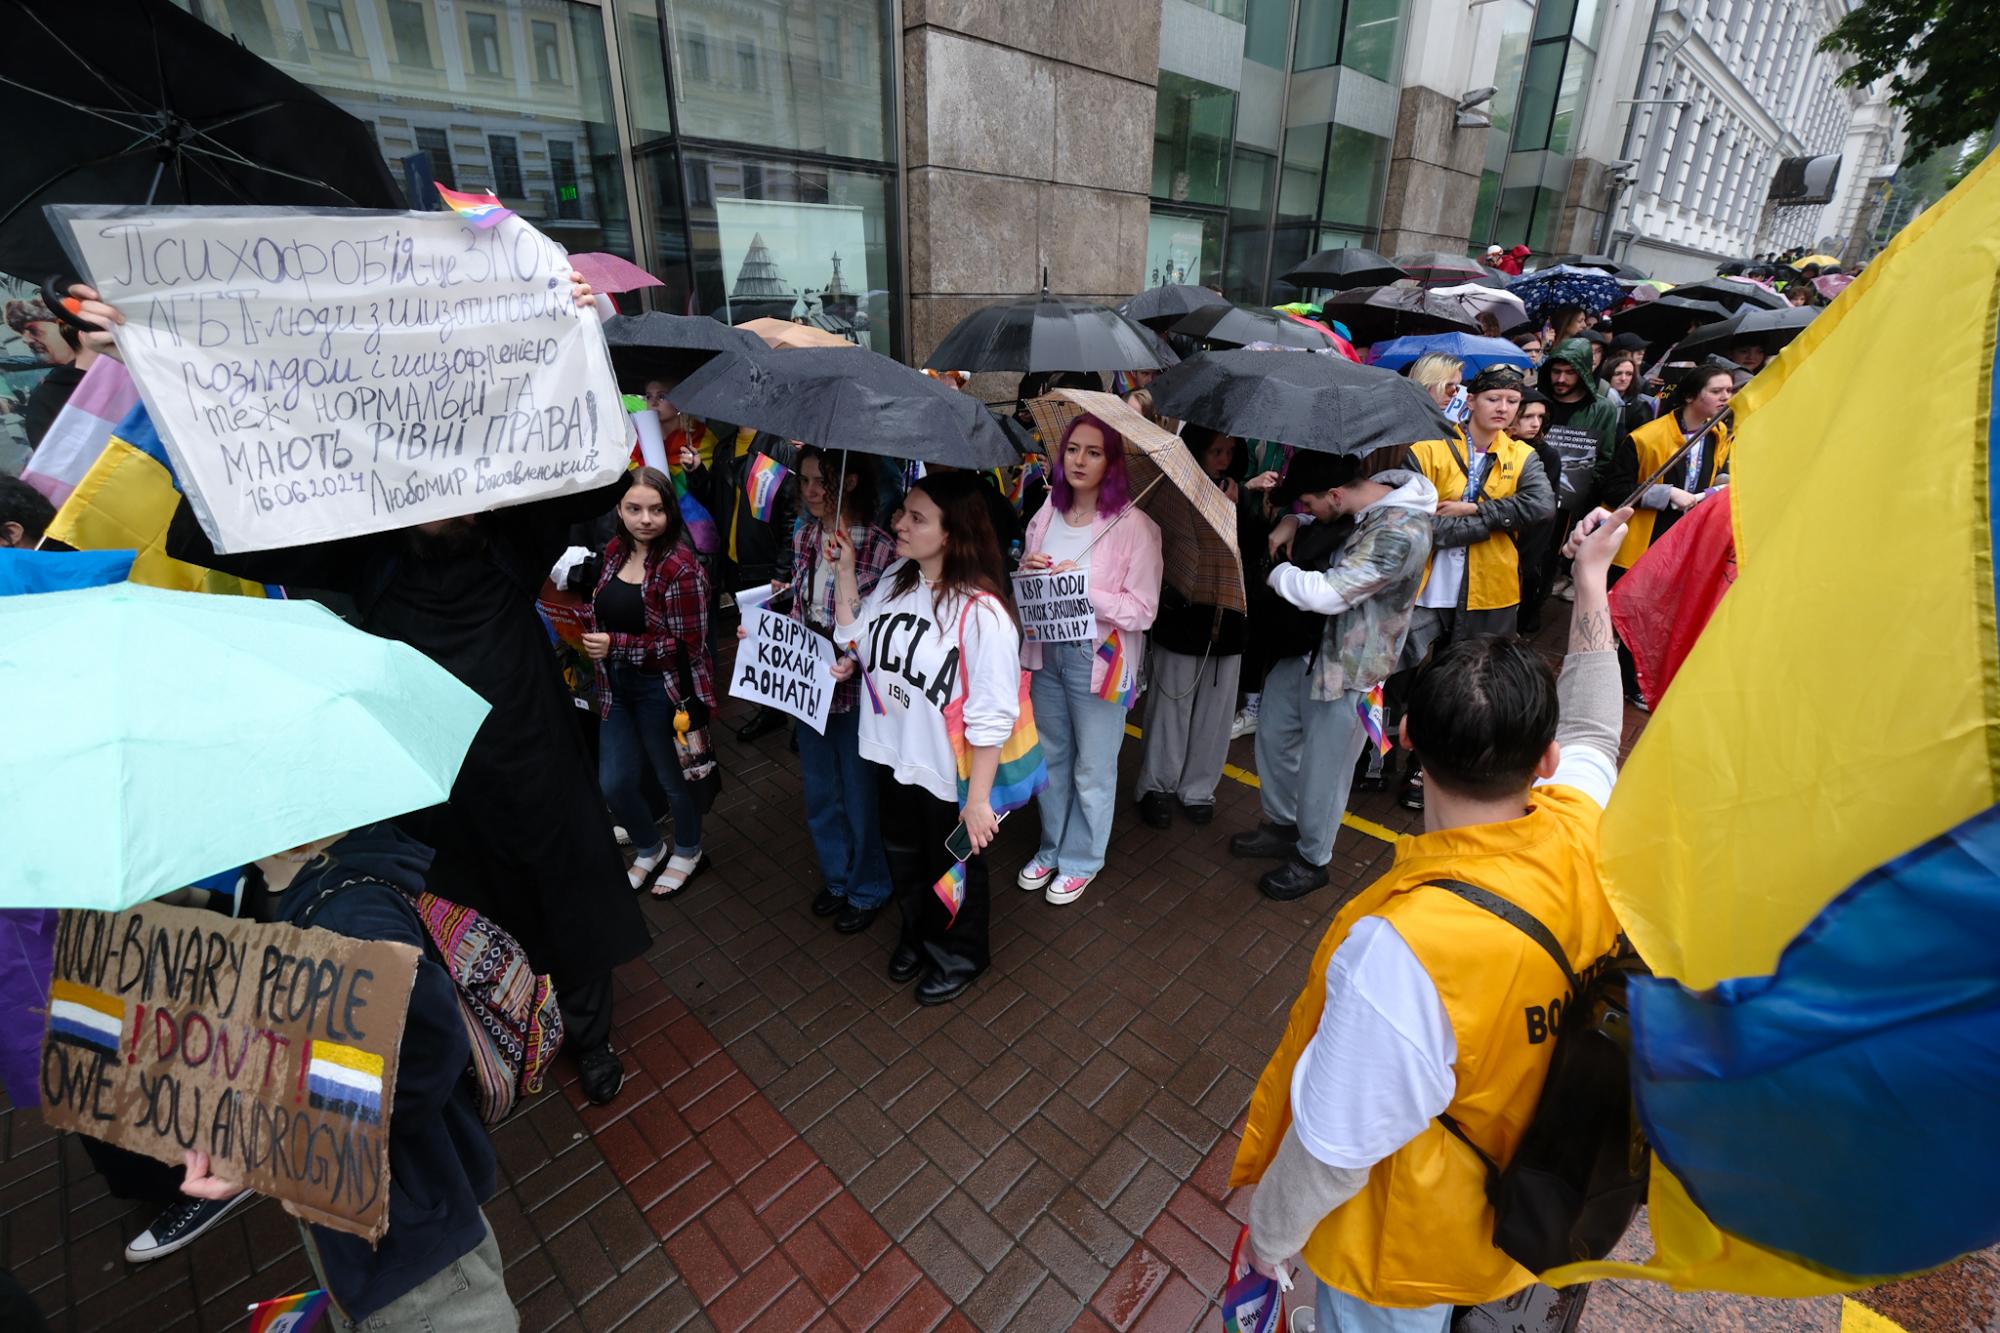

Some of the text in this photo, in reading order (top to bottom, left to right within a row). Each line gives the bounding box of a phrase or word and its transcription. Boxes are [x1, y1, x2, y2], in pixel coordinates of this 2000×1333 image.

[500, 371, 536, 413] ТА
[219, 428, 354, 485] МАЮТЬ
[482, 389, 599, 454] ПРАВА!
[1018, 601, 1047, 623] ТАКОЖ
[1035, 620, 1089, 640] УКРАЇНУ
[758, 642, 816, 684] КОХАЙ,
[867, 612, 960, 716] UCLA
[739, 665, 822, 720] ДОНАТЬ!
[256, 944, 375, 1042] PEOPLE
[43, 1042, 384, 1216] OWE YOU ANDROGYNY
